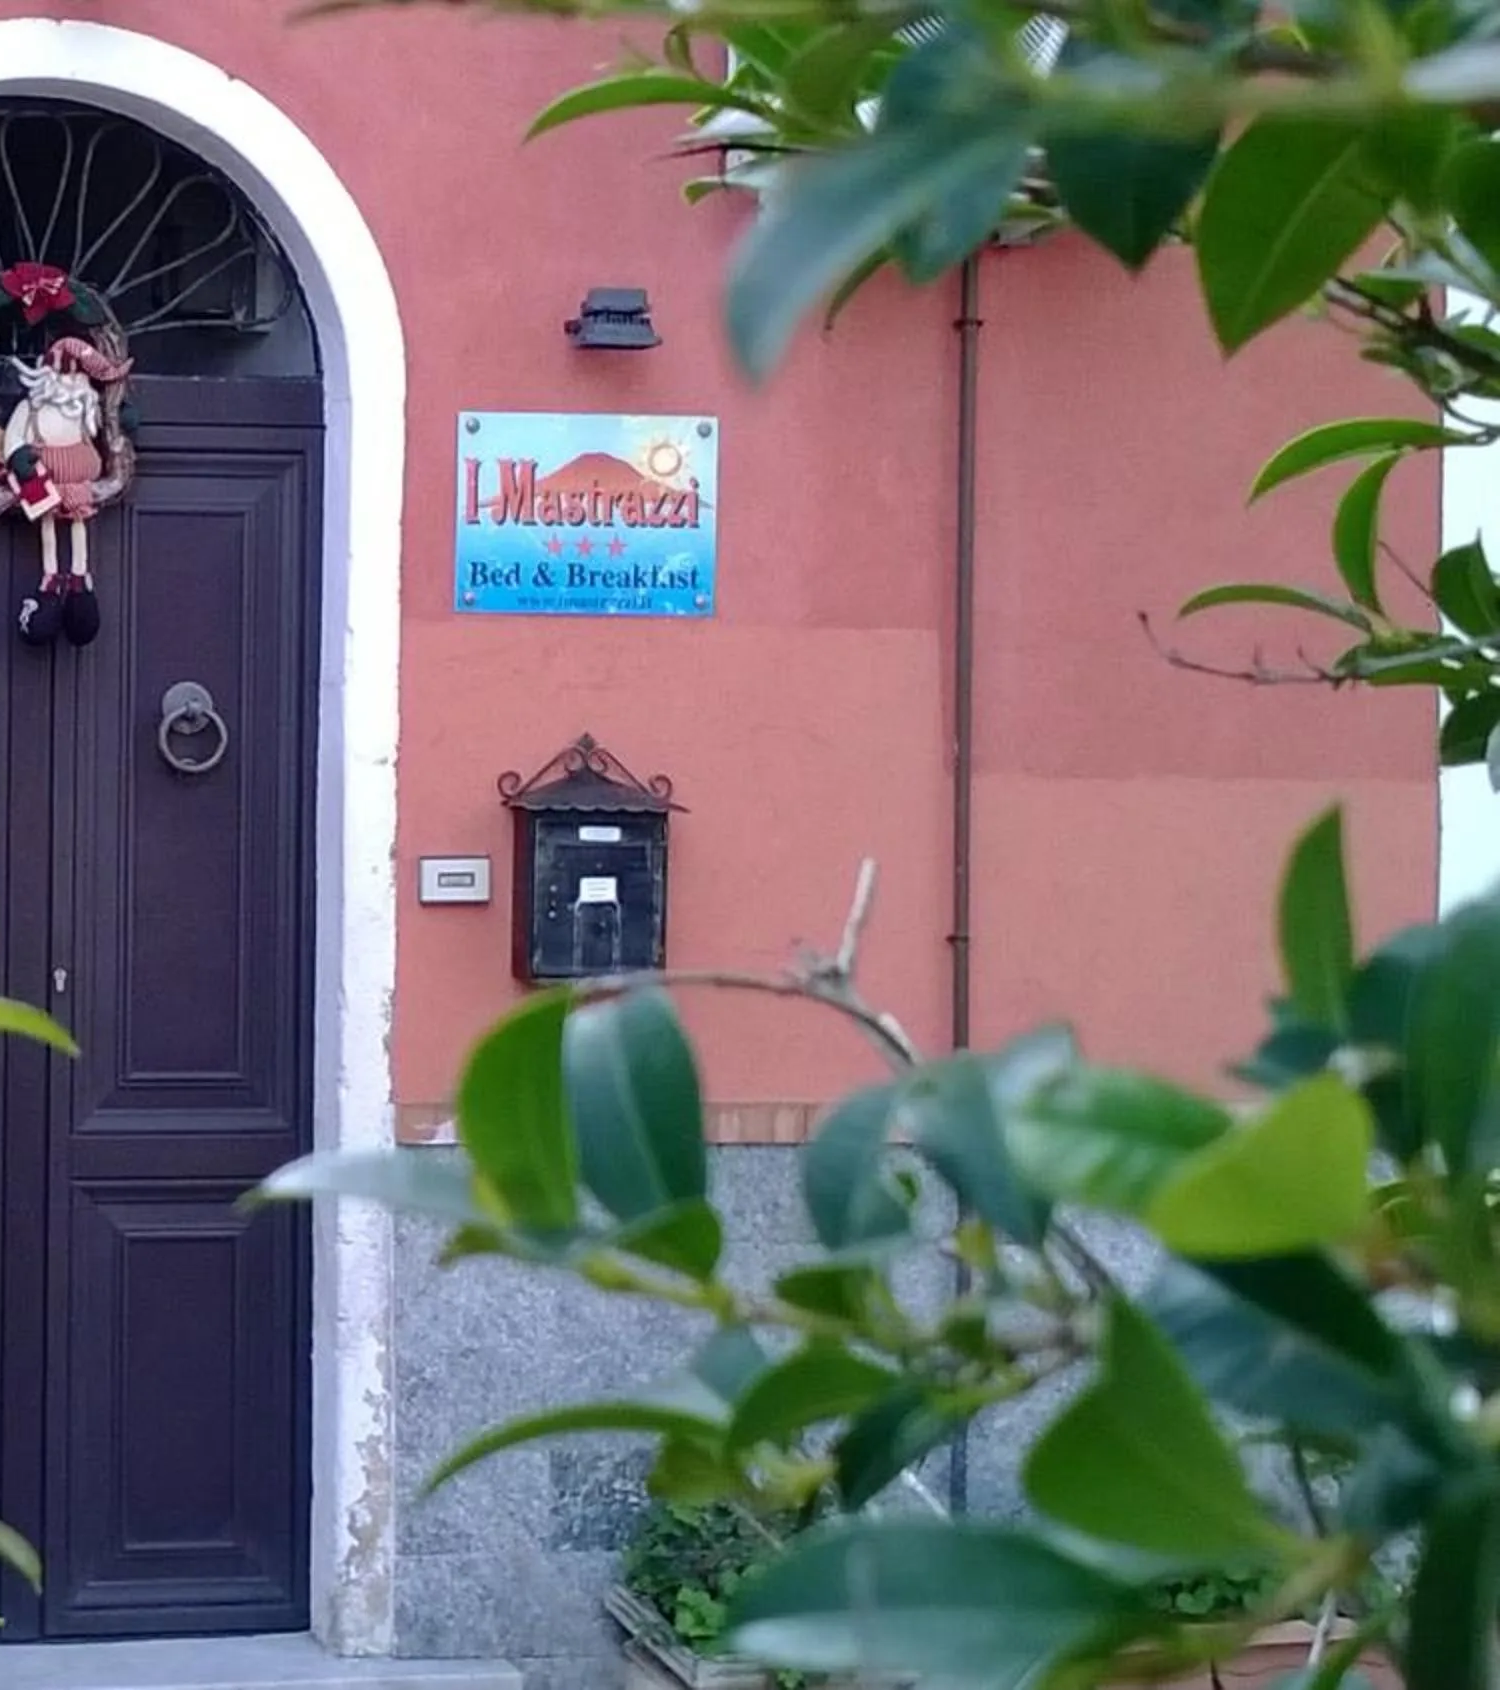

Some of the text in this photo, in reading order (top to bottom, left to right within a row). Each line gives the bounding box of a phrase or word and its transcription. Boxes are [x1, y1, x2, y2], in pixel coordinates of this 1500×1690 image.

[464, 457, 700, 529] I Mastrazzi
[470, 560, 699, 590] Bed & Breakfast
